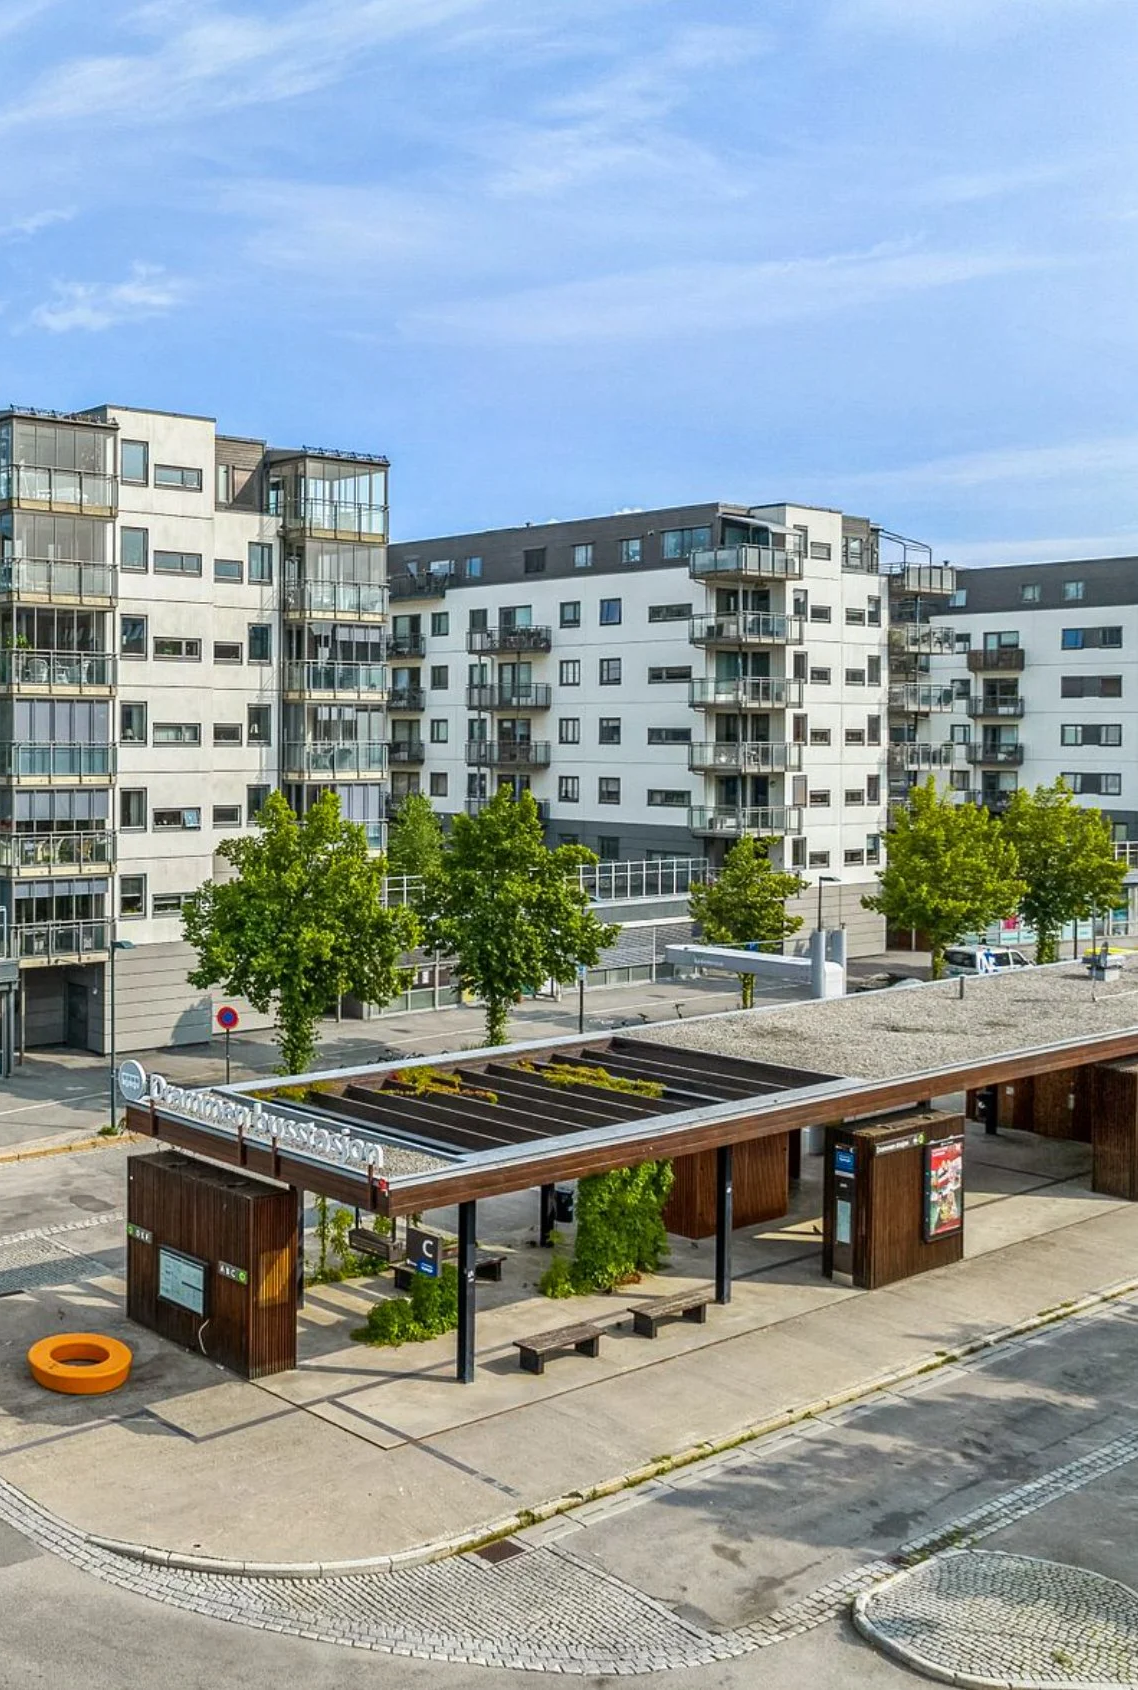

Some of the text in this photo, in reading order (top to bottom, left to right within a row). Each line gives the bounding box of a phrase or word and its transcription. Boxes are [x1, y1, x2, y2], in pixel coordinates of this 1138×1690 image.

[150, 1073, 383, 1168] Drammen busstasjon
[422, 1239, 434, 1258] C
